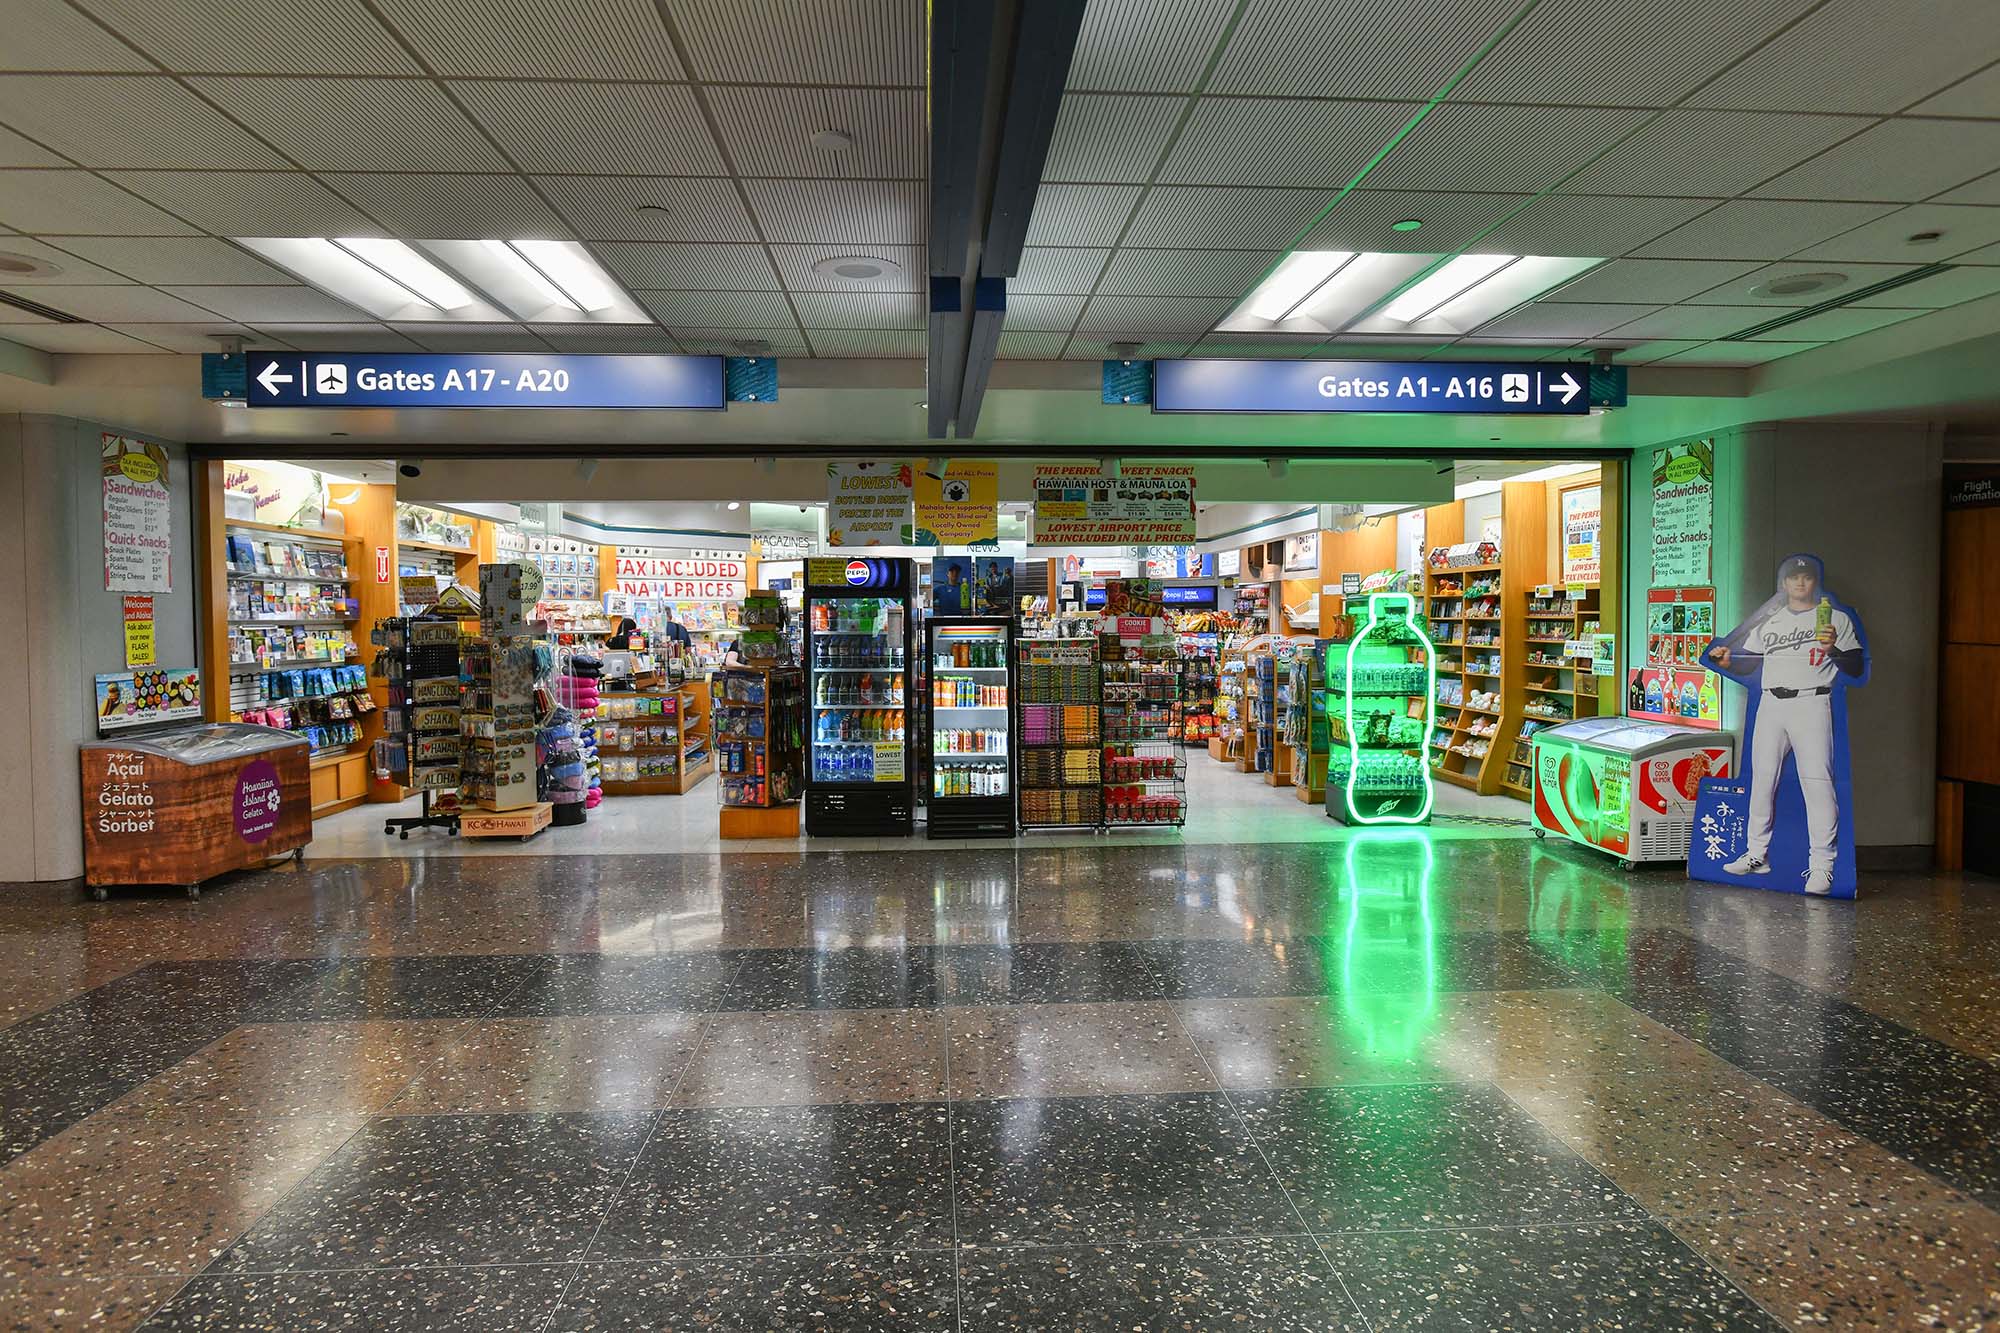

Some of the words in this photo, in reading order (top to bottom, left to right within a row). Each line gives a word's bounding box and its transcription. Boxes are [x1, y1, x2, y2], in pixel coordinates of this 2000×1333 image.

[356, 368, 435, 392] Gates
[442, 369, 496, 392] A17
[515, 369, 570, 392] A20
[1318, 375, 1389, 399] Gates
[1036, 467, 1060, 475] THE
[1061, 467, 1102, 475] PERFEC
[1120, 467, 1152, 475] WEET
[1154, 466, 1194, 475] SNACK!
[841, 476, 899, 490] LOWEST
[1038, 480, 1089, 489] HAWAIIAN
[1091, 480, 1117, 489] HOST
[1120, 480, 1128, 488] &
[1129, 480, 1165, 489] MAUNA
[1168, 480, 1186, 489] LOA
[1964, 480, 1991, 492] Flight
[108, 479, 167, 500] Sandwiches
[1656, 482, 1709, 501] Sandwiches
[839, 508, 872, 518] PRICES
[872, 508, 885, 518] IN
[886, 508, 904, 518] THE
[956, 504, 993, 512] supporting
[932, 522, 954, 530] Locally
[1048, 524, 1096, 532] LOWEST
[1098, 524, 1144, 532] AIRPORT
[1145, 524, 1182, 532] PRICE
[109, 532, 136, 546] Quick
[138, 534, 167, 549] Snacks
[753, 535, 810, 548] MAGAZINES
[1036, 534, 1057, 542] TAX
[1060, 534, 1116, 542] INCLUDED
[1117, 534, 1130, 542] IN
[1132, 534, 1152, 542] ALL
[1154, 534, 1194, 542] PRICES
[1656, 532, 1678, 545] Quick
[1680, 530, 1708, 544] Snacks
[967, 544, 1000, 552] NEWS
[616, 560, 647, 575] TAX
[1572, 564, 1596, 572] LOWEST
[126, 600, 152, 609] Welcome
[127, 623, 136, 631] Ask
[132, 643, 149, 651] FLASH
[132, 653, 150, 661] SALES!
[1808, 648, 1826, 667] 17
[417, 686, 436, 697] HANG
[424, 714, 453, 725] SHAKA
[106, 754, 144, 762] アサイー
[107, 760, 144, 780] Açaí
[424, 773, 456, 784] ALOHA
[102, 782, 149, 790] ジェラート
[242, 778, 274, 794] Hawaiian
[100, 792, 154, 806] Gelato
[99, 818, 154, 833] Sorbet
[467, 820, 480, 830] KC
[1700, 814, 1728, 860] お茶
